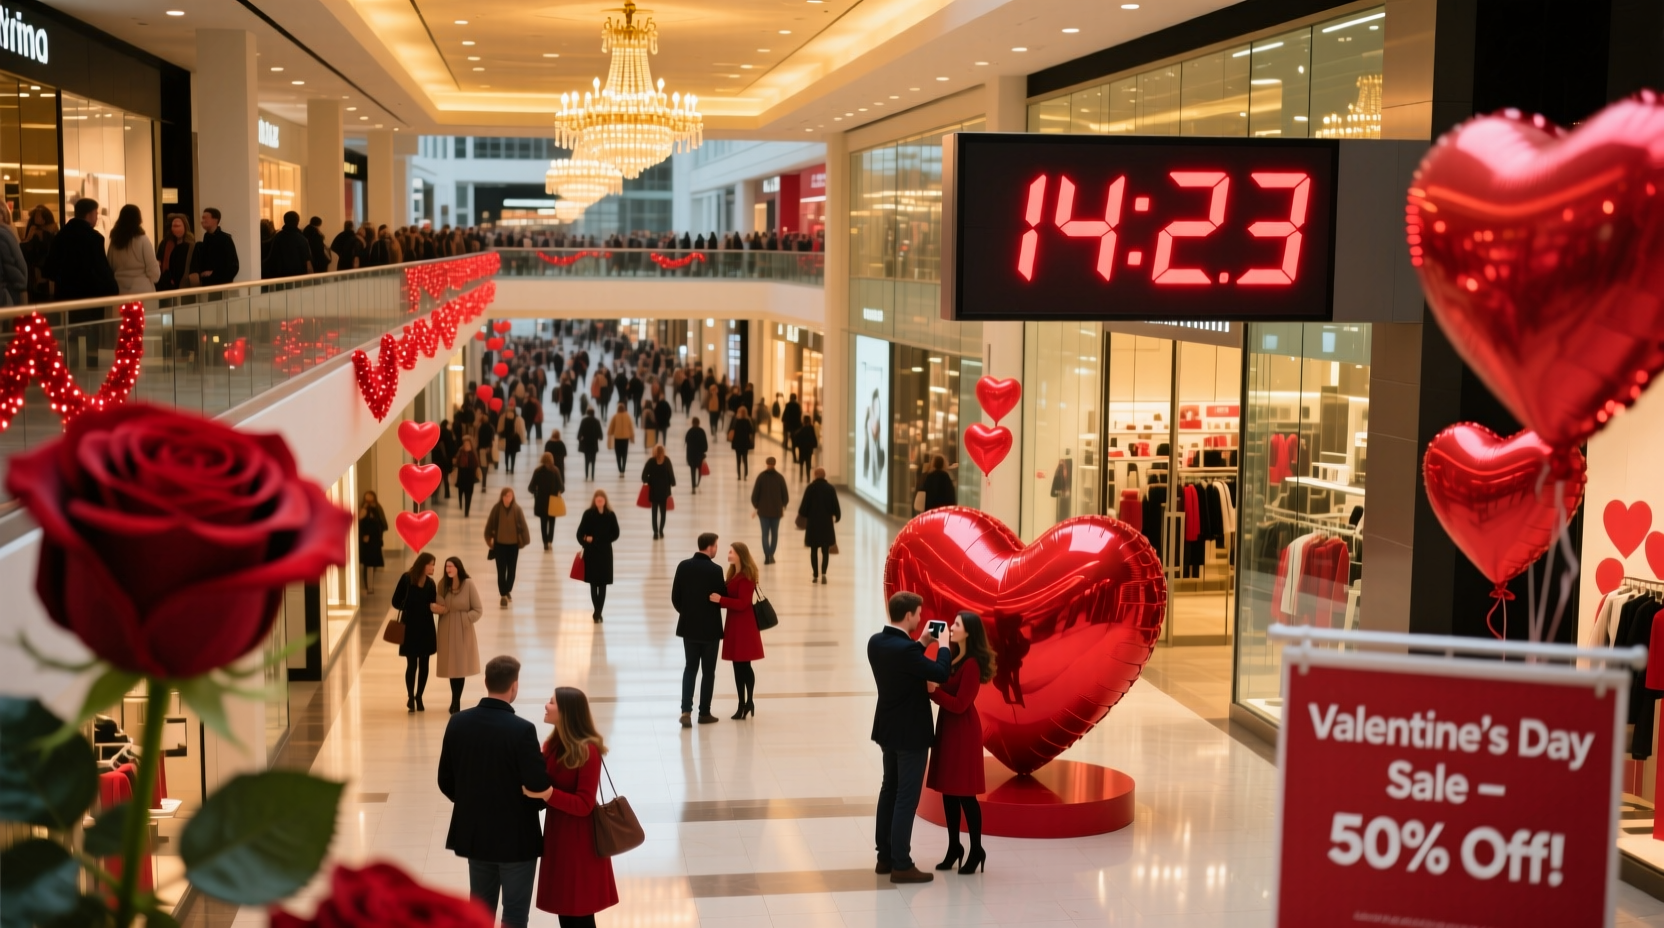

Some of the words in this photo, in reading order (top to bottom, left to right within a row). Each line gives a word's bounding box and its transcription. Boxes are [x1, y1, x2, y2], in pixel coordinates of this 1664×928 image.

[1308, 702, 1509, 756] Valentine’s
[1518, 718, 1595, 771] Day
[1386, 759, 1469, 804] Sale
[1327, 812, 1450, 875] 50%
[1460, 826, 1565, 888] Off!
